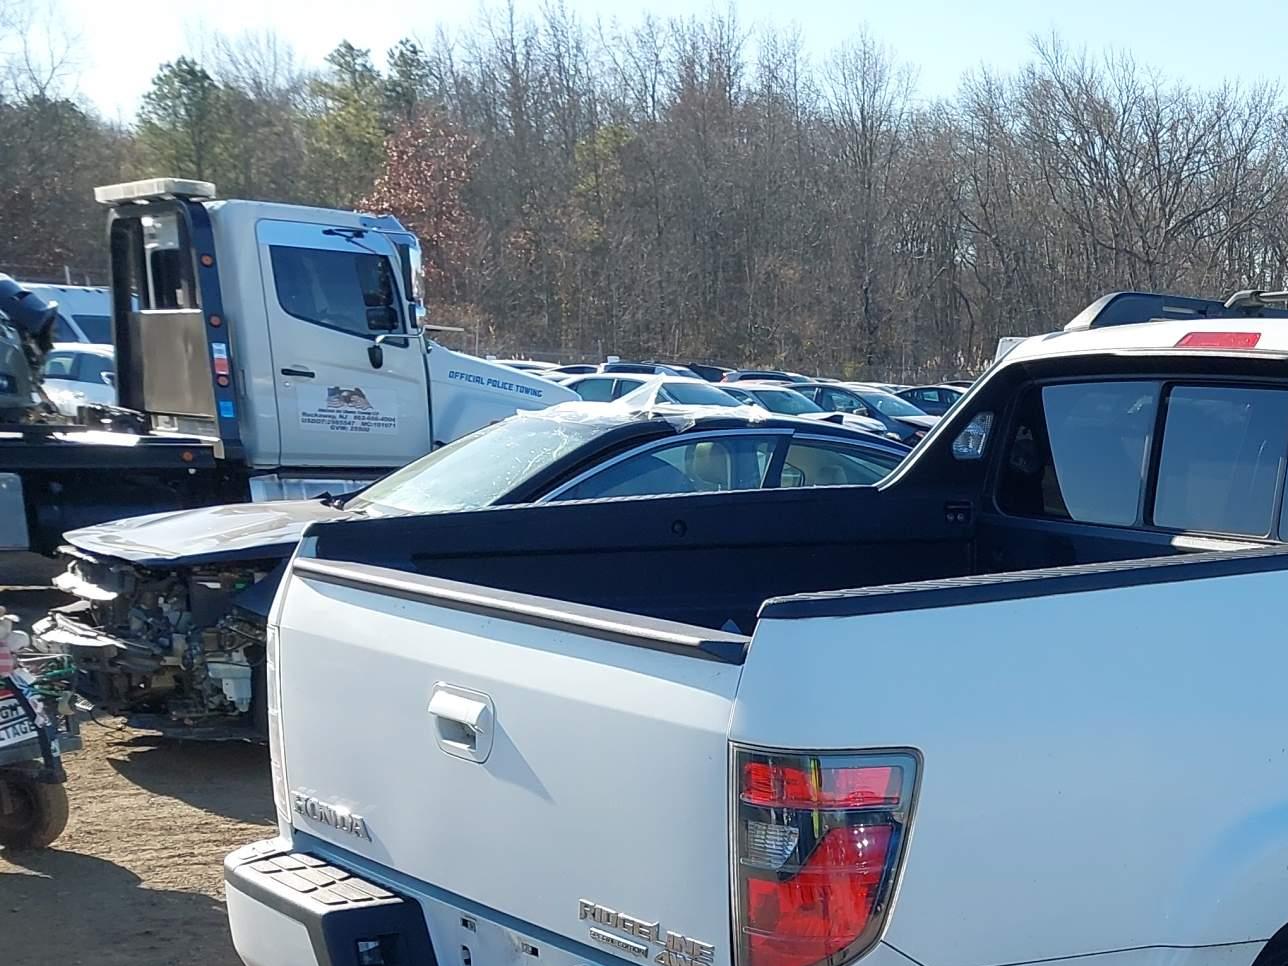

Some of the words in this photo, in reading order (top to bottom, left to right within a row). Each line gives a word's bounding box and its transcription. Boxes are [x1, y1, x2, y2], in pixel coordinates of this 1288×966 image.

[448, 370, 485, 386] OFFICIAL
[486, 378, 513, 391] POLICE
[515, 384, 543, 397] TOWING
[290, 790, 371, 841] HONDA
[579, 898, 716, 963] RIDGELINE
